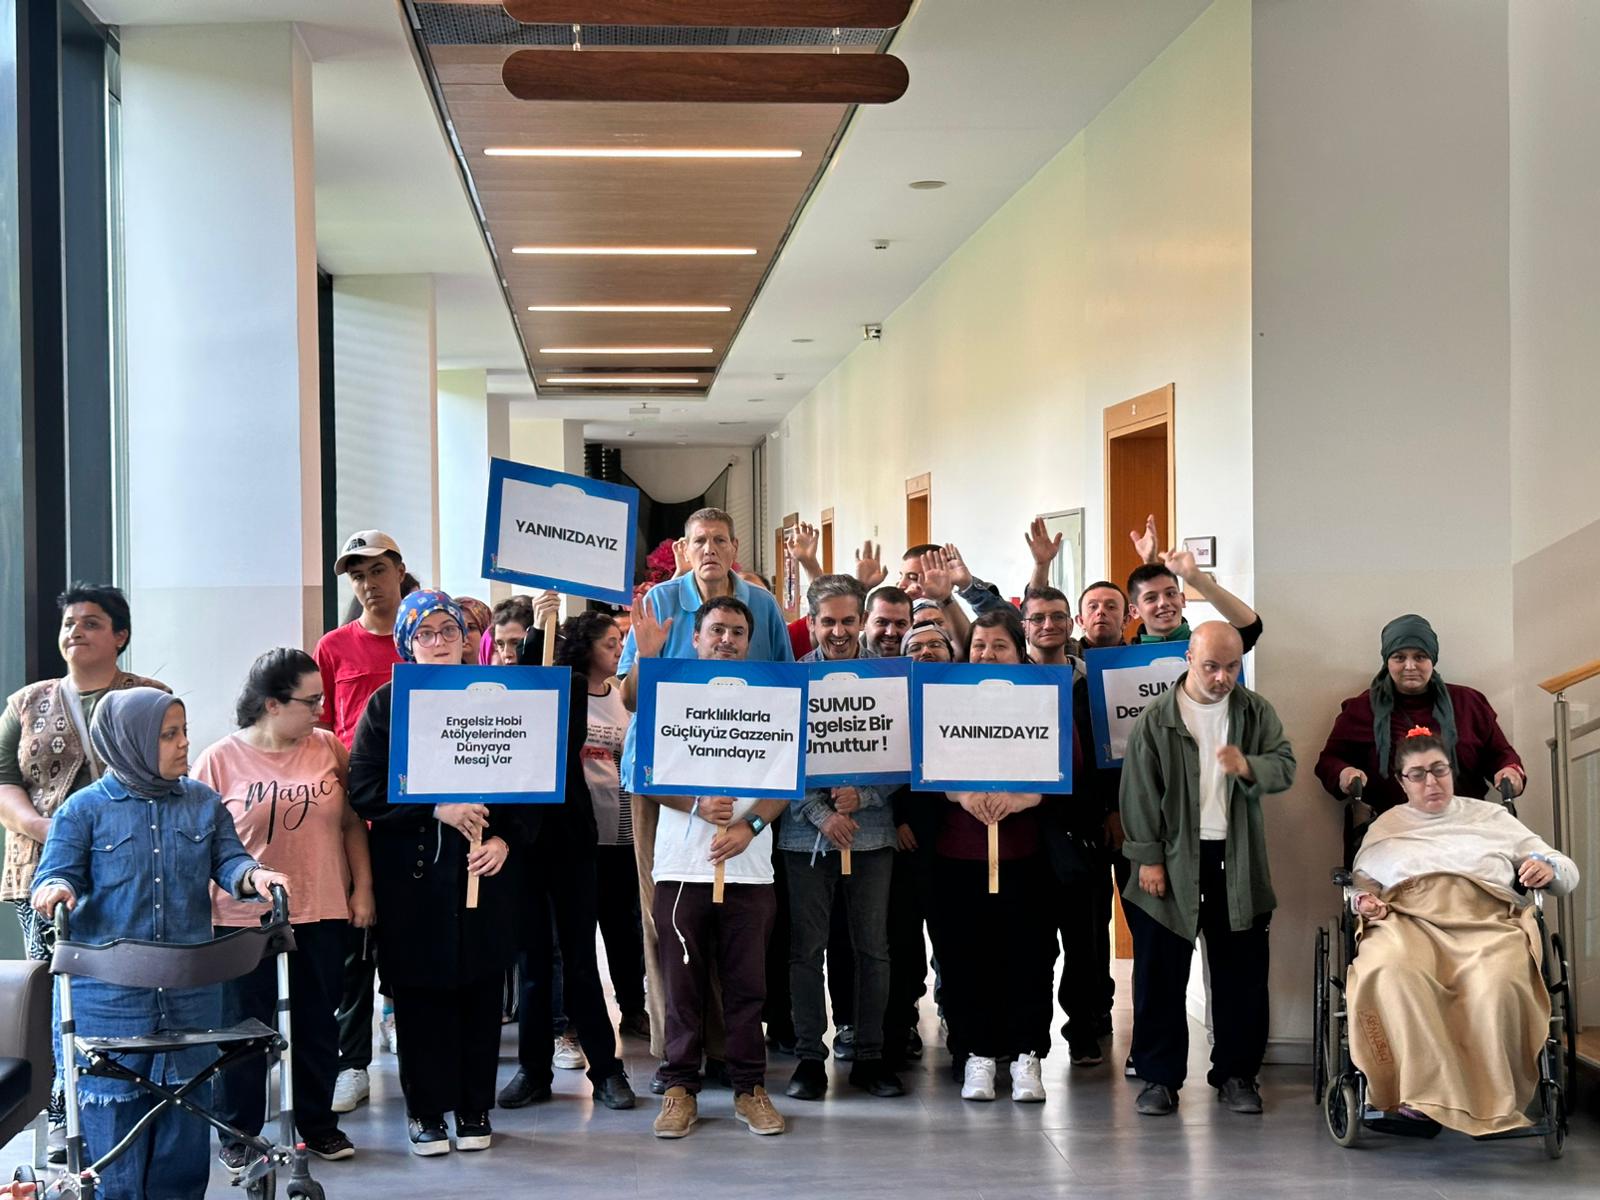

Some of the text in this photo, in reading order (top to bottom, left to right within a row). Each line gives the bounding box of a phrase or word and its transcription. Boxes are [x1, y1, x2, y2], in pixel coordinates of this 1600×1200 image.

[516, 519, 618, 551] YANINIZDAYIZ
[808, 696, 876, 713] SUMUD
[446, 715, 522, 729] Engelsiz Hobi
[686, 707, 771, 723] Farklılıklarla
[661, 724, 793, 742] Güçlüyüz Gazzenin
[806, 714, 893, 738] ngelsiz Bir
[939, 725, 1049, 739] YANINIZDAYIZ
[440, 728, 527, 742] Atölyelerinden
[456, 742, 510, 755] Dünyaya
[882, 736, 888, 751] !
[454, 754, 512, 767] Mesaj Var
[688, 744, 766, 762] Yanındayız
[245, 780, 333, 844] Magic
